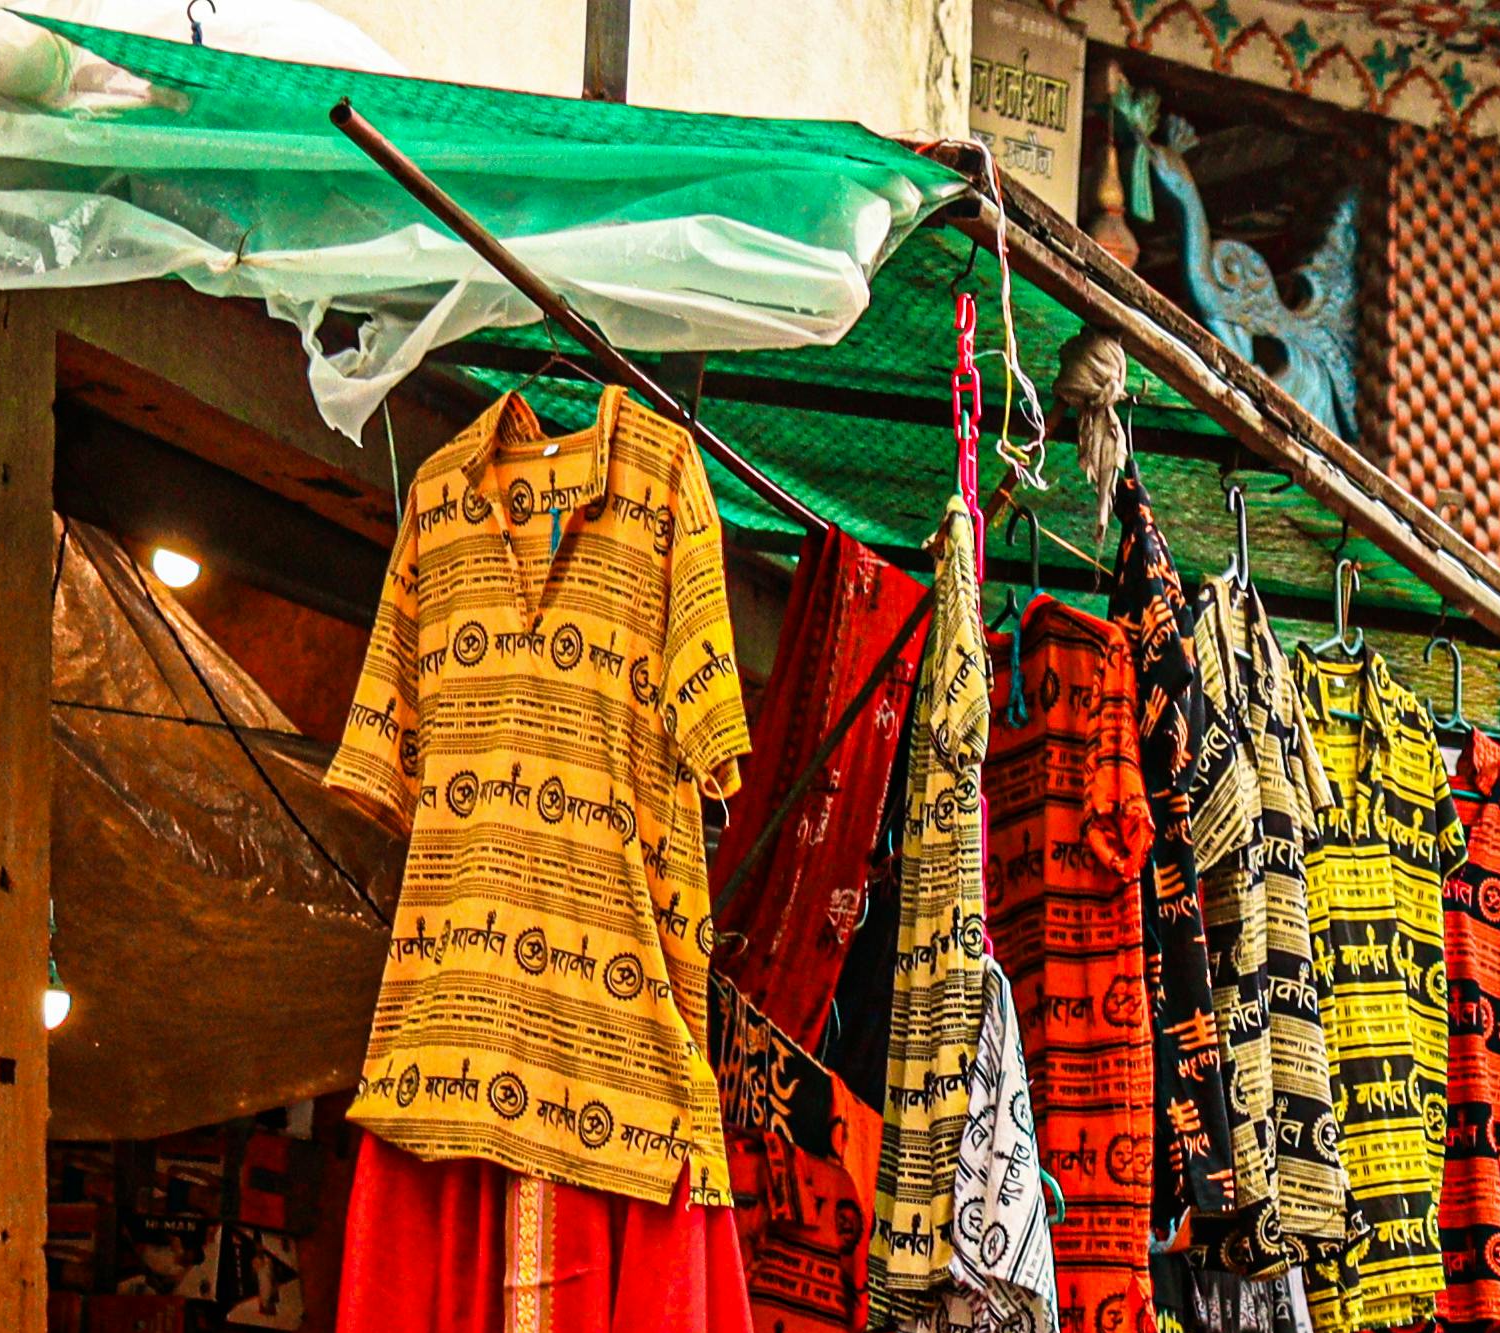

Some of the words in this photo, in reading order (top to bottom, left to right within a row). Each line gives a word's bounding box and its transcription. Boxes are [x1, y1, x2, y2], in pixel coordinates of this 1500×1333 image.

[494, 614, 545, 659] महाकाल
[676, 639, 735, 705] महाकाल
[451, 910, 507, 956] महाकाल
[425, 1058, 479, 1102] महाकाल
[620, 1115, 690, 1161] महाकाल
